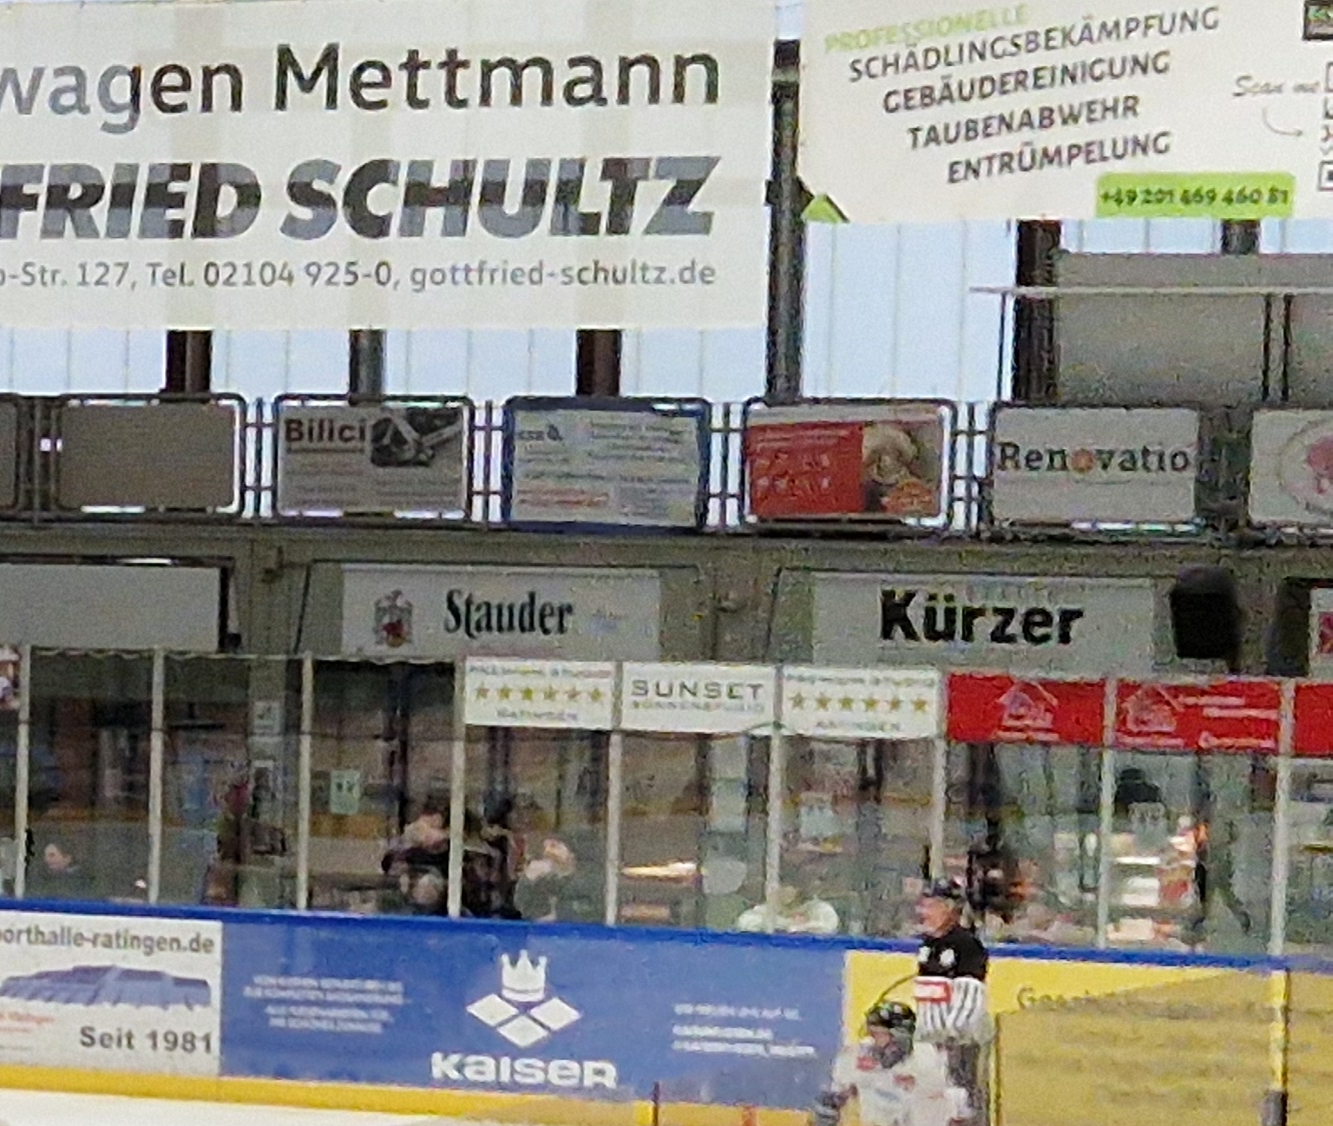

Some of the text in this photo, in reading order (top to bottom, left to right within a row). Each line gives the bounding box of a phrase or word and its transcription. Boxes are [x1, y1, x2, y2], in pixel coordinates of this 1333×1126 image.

[849, 6, 1220, 82] SCHÄDLINGSBEKÄMPFUNG
[273, 42, 720, 113] Mettmann
[883, 50, 1171, 113] GEBÄUDEREINIGUNG
[908, 95, 1140, 150] TAUBENABWEHR
[948, 131, 1172, 184] ENTRÜMPELUNG
[279, 156, 722, 241] SCHULTZ
[77, 262, 138, 291] 127,
[146, 262, 194, 288] Tel.
[203, 261, 295, 288] 02104
[304, 261, 401, 291] 925-0,
[410, 259, 717, 293] gottfried-schultz.de
[998, 440, 1190, 473] Renovatio
[444, 589, 573, 639] Stauder
[881, 588, 1084, 645] Kürzer
[632, 680, 764, 700] SUNSET
[80, 1026, 213, 1054] Seit 1981
